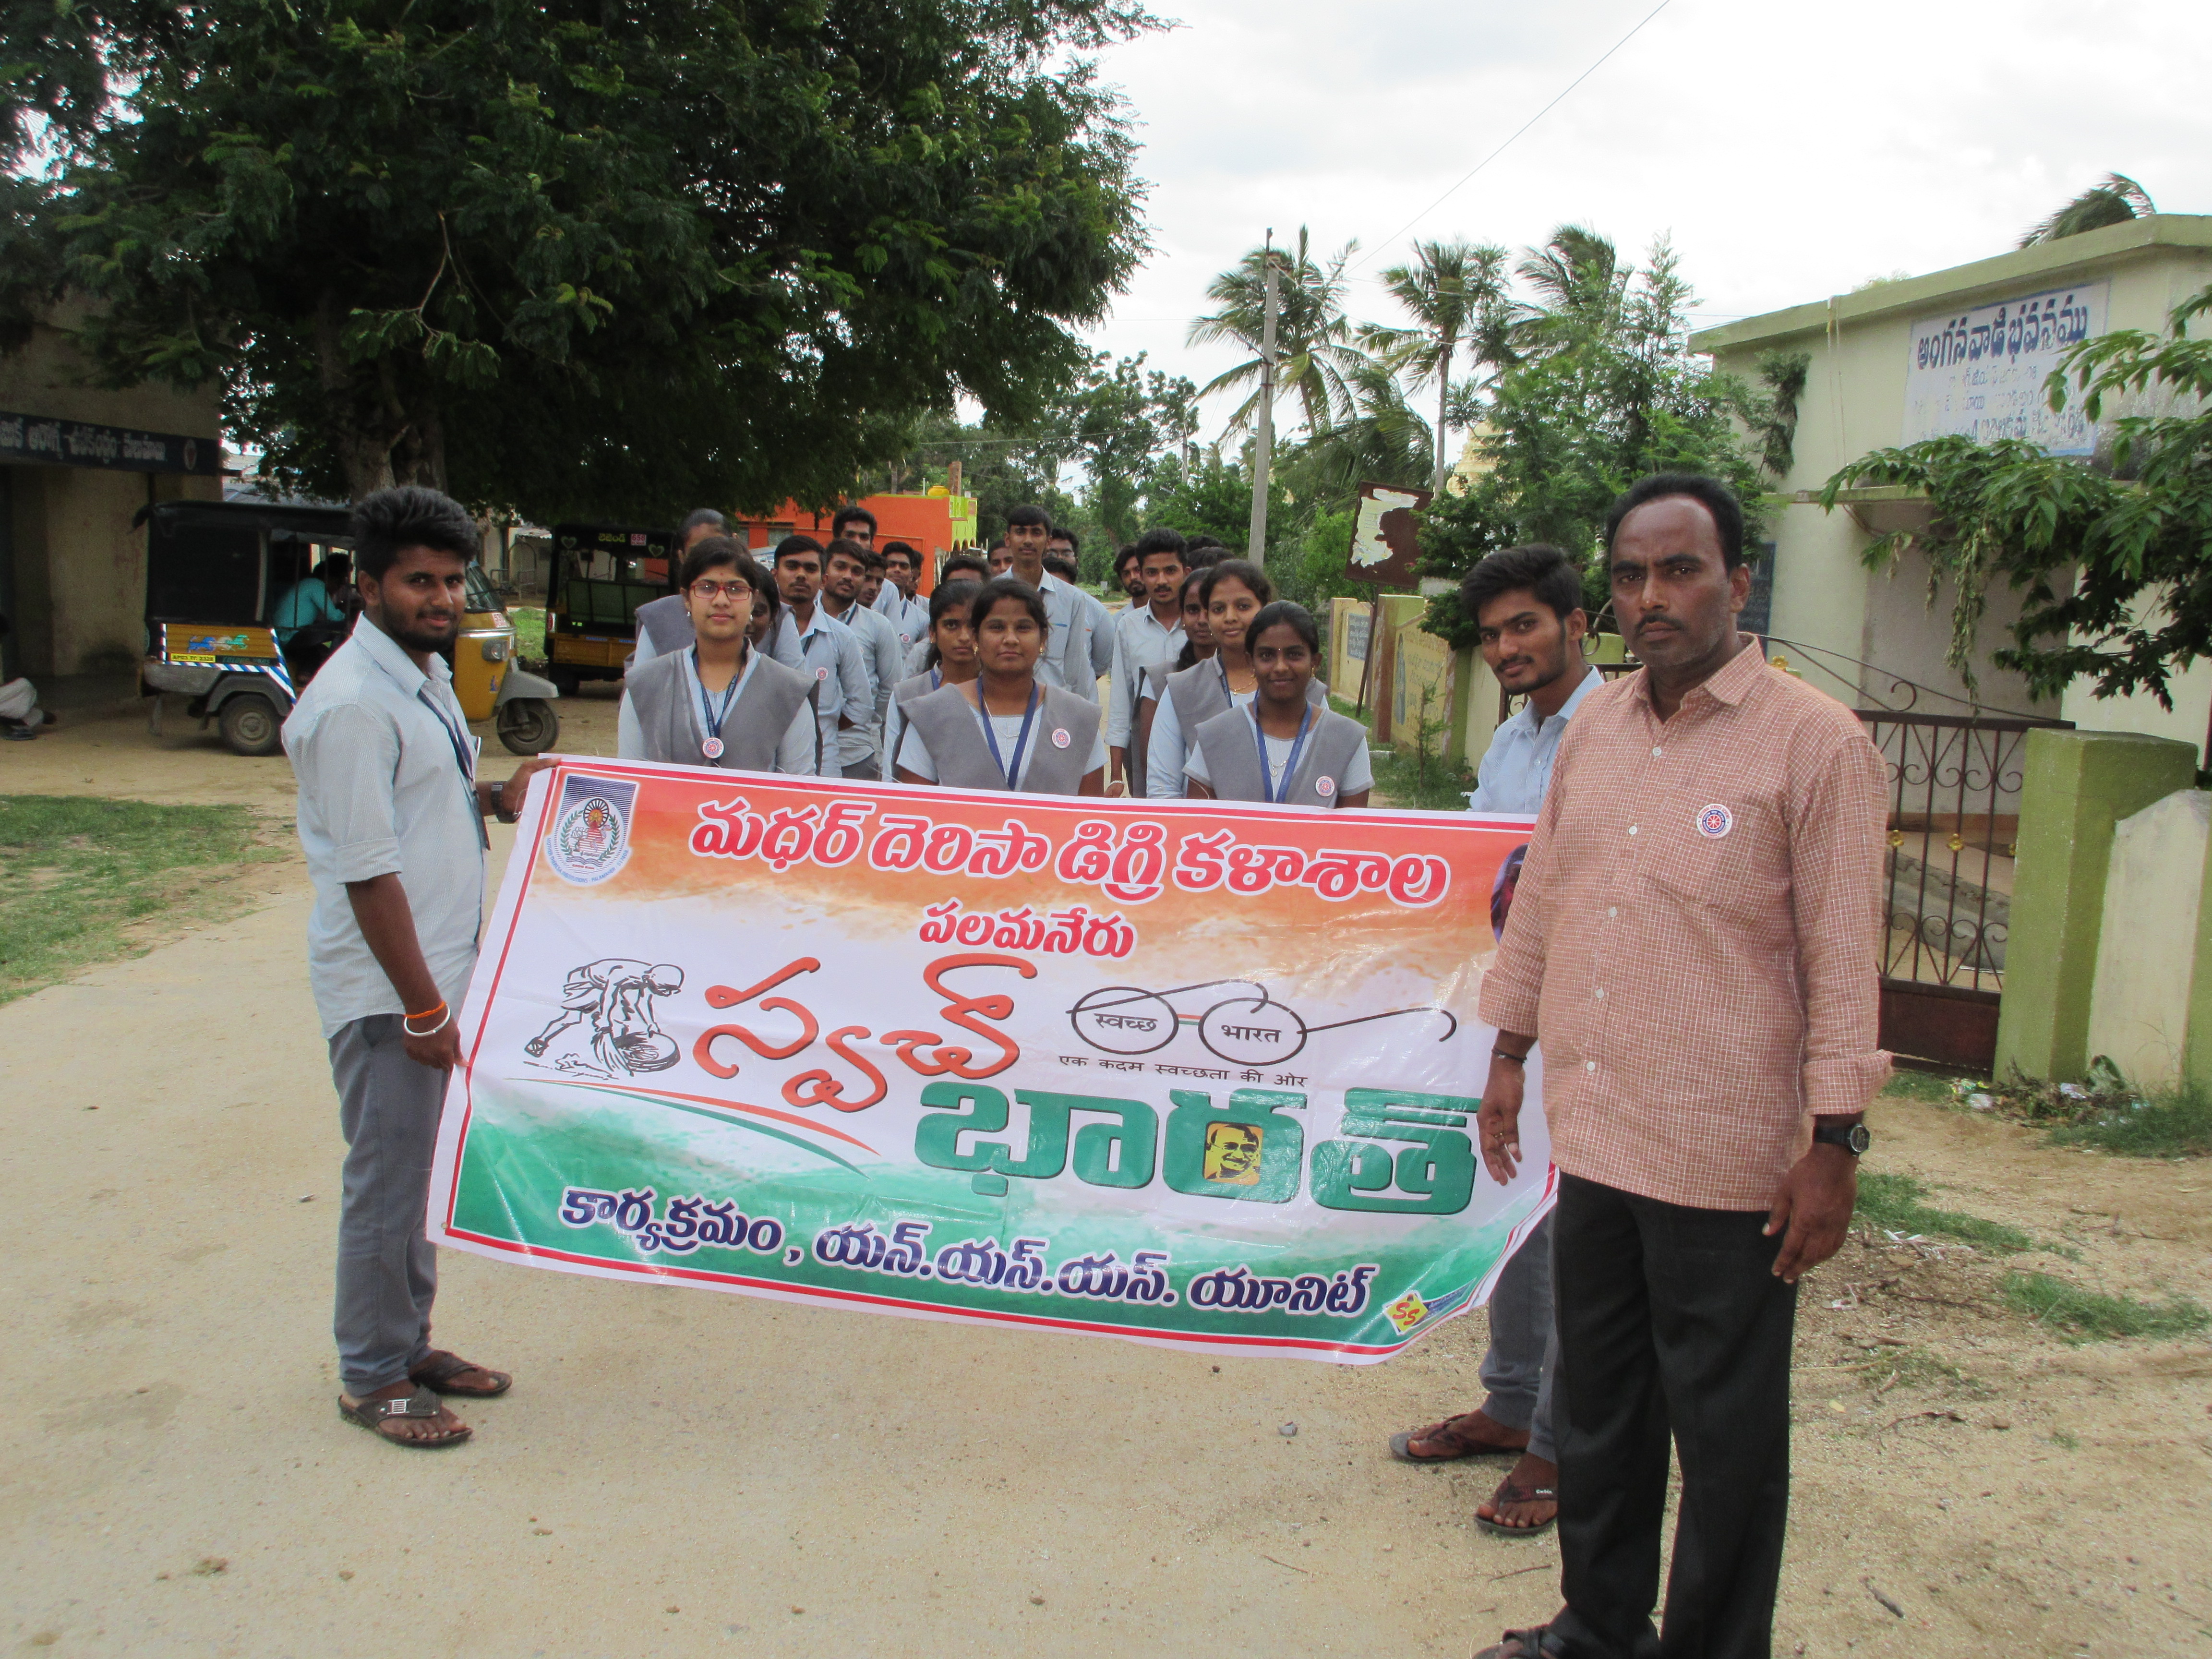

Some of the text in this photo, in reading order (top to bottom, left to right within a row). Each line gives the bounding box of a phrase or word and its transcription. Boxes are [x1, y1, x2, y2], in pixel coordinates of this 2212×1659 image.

[691, 799, 1449, 905] మధర్ దెరిసా డిగ్రి కళాశాల
[918, 900, 1136, 959] పలమనేరు
[1094, 1012, 1158, 1032] स्वच्छ
[1220, 1024, 1282, 1043] भारत
[1058, 1056, 1309, 1088] एक कदम स्वच्छता की ओर
[914, 1081, 1484, 1215] భారత్
[1190, 1266, 1377, 1313] యూనిట్
